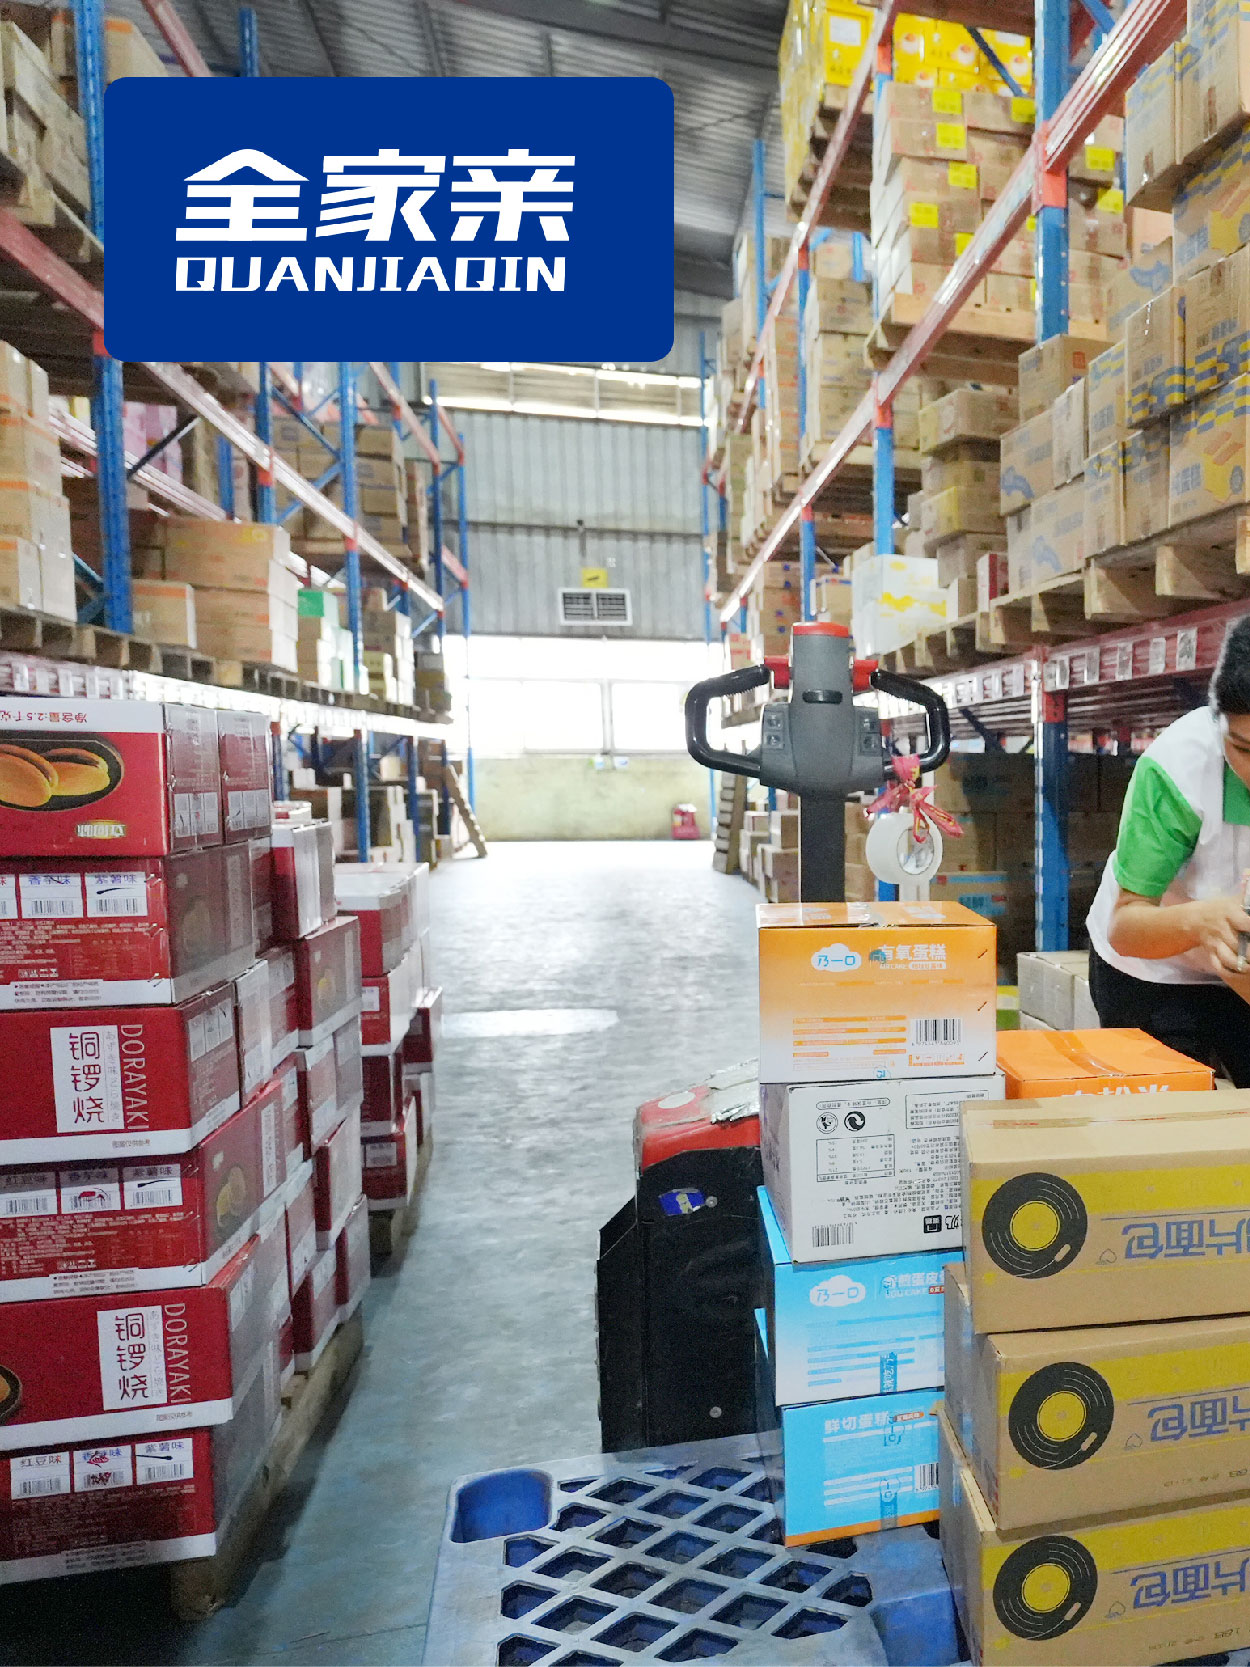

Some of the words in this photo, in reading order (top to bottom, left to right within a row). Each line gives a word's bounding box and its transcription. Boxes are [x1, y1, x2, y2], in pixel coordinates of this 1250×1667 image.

[817, 954, 857, 968] 乃一口
[69, 1031, 105, 1123] 铜锣烧
[120, 1024, 150, 1130] DORAYAKI
[816, 1286, 860, 1302] 乃一口
[115, 1312, 149, 1400] 铜锣烧
[164, 1302, 192, 1403] DORAYAKI
